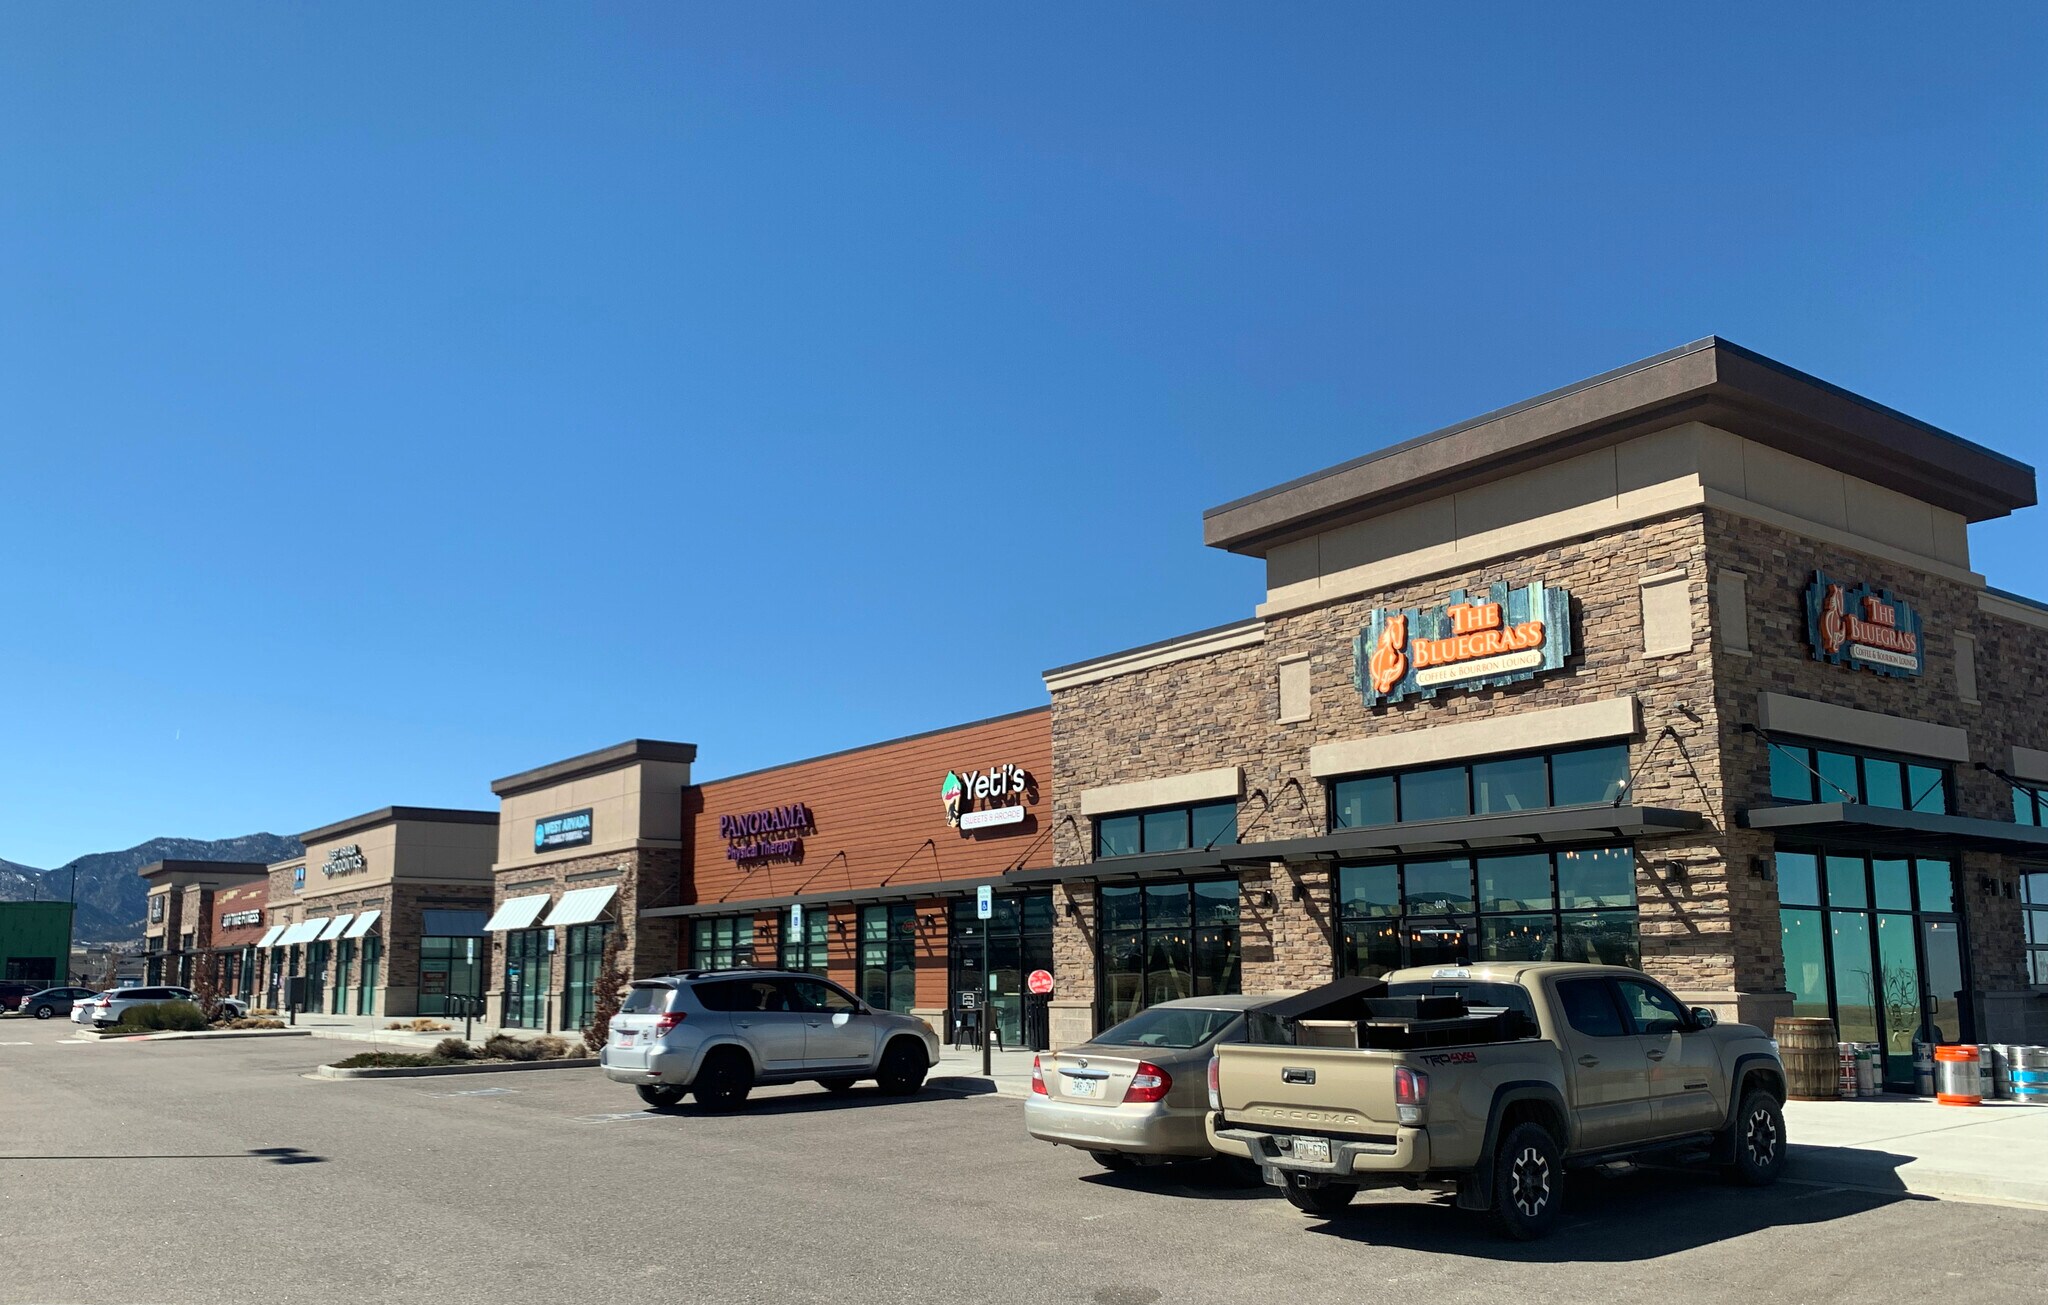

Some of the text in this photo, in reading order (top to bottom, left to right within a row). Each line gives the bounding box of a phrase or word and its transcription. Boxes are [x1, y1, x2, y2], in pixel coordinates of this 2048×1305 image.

[1449, 603, 1499, 634] THE
[1868, 598, 1895, 624] THE
[1414, 623, 1542, 666] BLUEGRASS
[1851, 616, 1917, 651] BLUEGRASS
[1418, 654, 1538, 683] COFFEE & BOURBON LOUNGE
[962, 763, 1025, 800] Yeti's
[720, 802, 808, 838] PANORAMA
[964, 815, 988, 825] SWEETS
[994, 809, 1021, 820] ARCADE
[727, 840, 794, 861] Physical Therapy
[322, 855, 362, 875] ORTHODONTICS
[1435, 900, 1446, 908] 400
[1257, 1107, 1359, 1124] TACOMA
